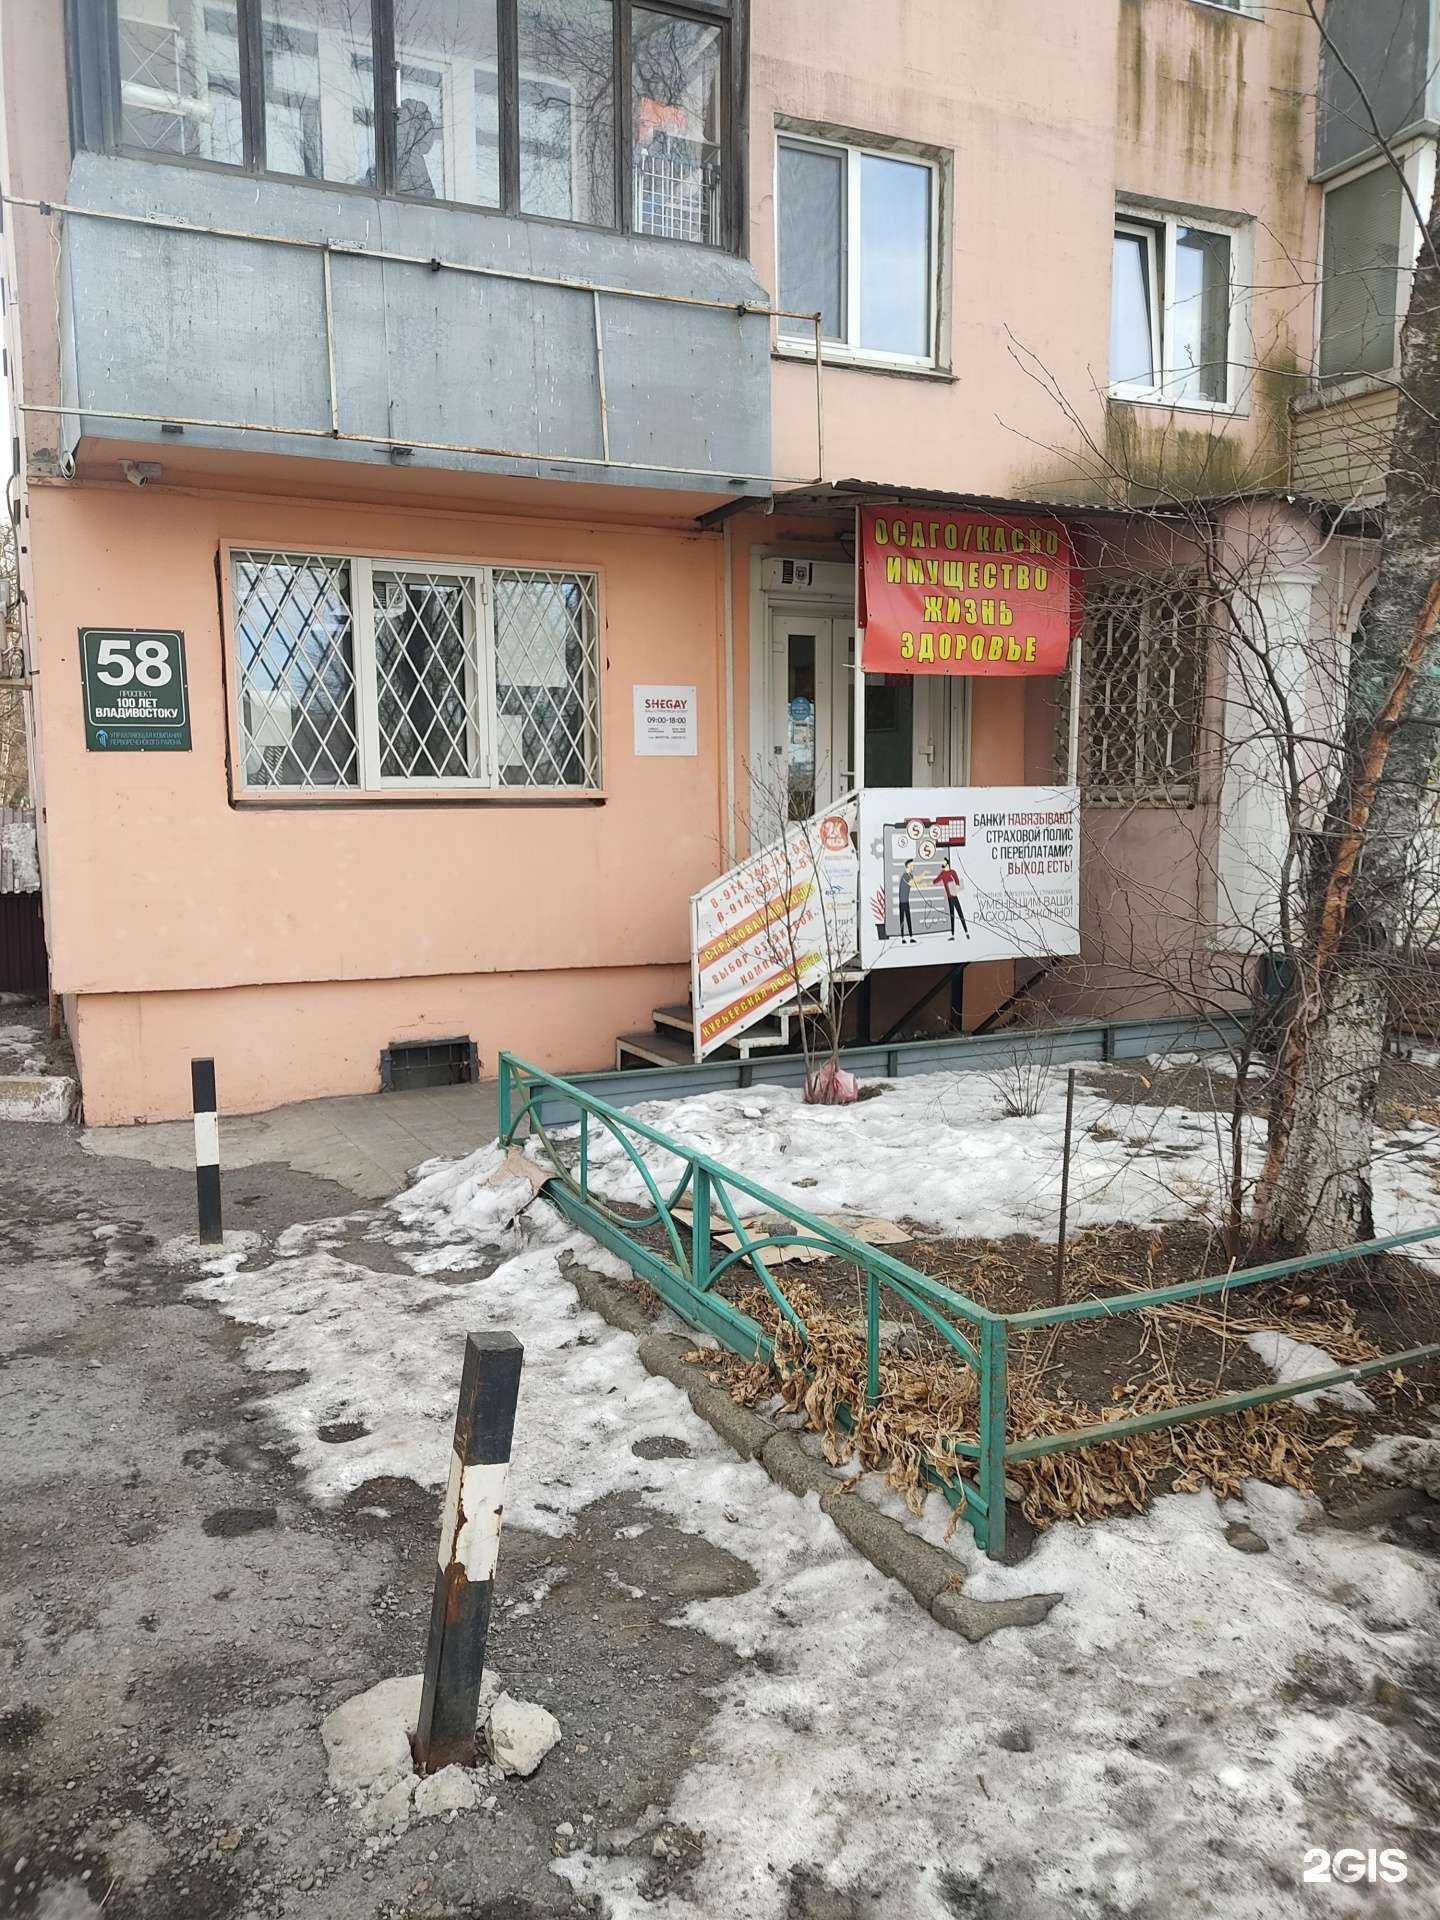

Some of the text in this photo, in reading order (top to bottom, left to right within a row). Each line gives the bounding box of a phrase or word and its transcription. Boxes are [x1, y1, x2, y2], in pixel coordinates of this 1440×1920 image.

[875, 518, 1058, 556] ОСАГО/КАСКО
[886, 555, 1048, 592] ИМУЩЕСТВО
[923, 595, 1014, 626] ЖИЗНЬ
[900, 631, 1037, 664] ЗДОРОВЬЕ
[97, 640, 172, 687] 58
[119, 690, 152, 698] ПРОСПЕКТ
[116, 698, 158, 708] 100 ЛЕТ
[645, 698, 688, 709] SHEGAY
[95, 707, 178, 719] ВЛАДИВОСТОКУ
[647, 716, 687, 724] 09:00-18:00
[973, 812, 1073, 827] БАНКИ НАВЯЗЫВАЮТ
[986, 827, 1074, 844] СТРАХОВОЙ ПОЛИС
[991, 845, 1074, 860] С ПЕРЕПЛАТАМИ?
[1008, 860, 1073, 875] ВЫХОД ЕСТЬ!
[1043, 896, 1073, 907] ВАШИ
[712, 952, 750, 985] ВЫБОР
[770, 952, 822, 993] ДОСАВКА
